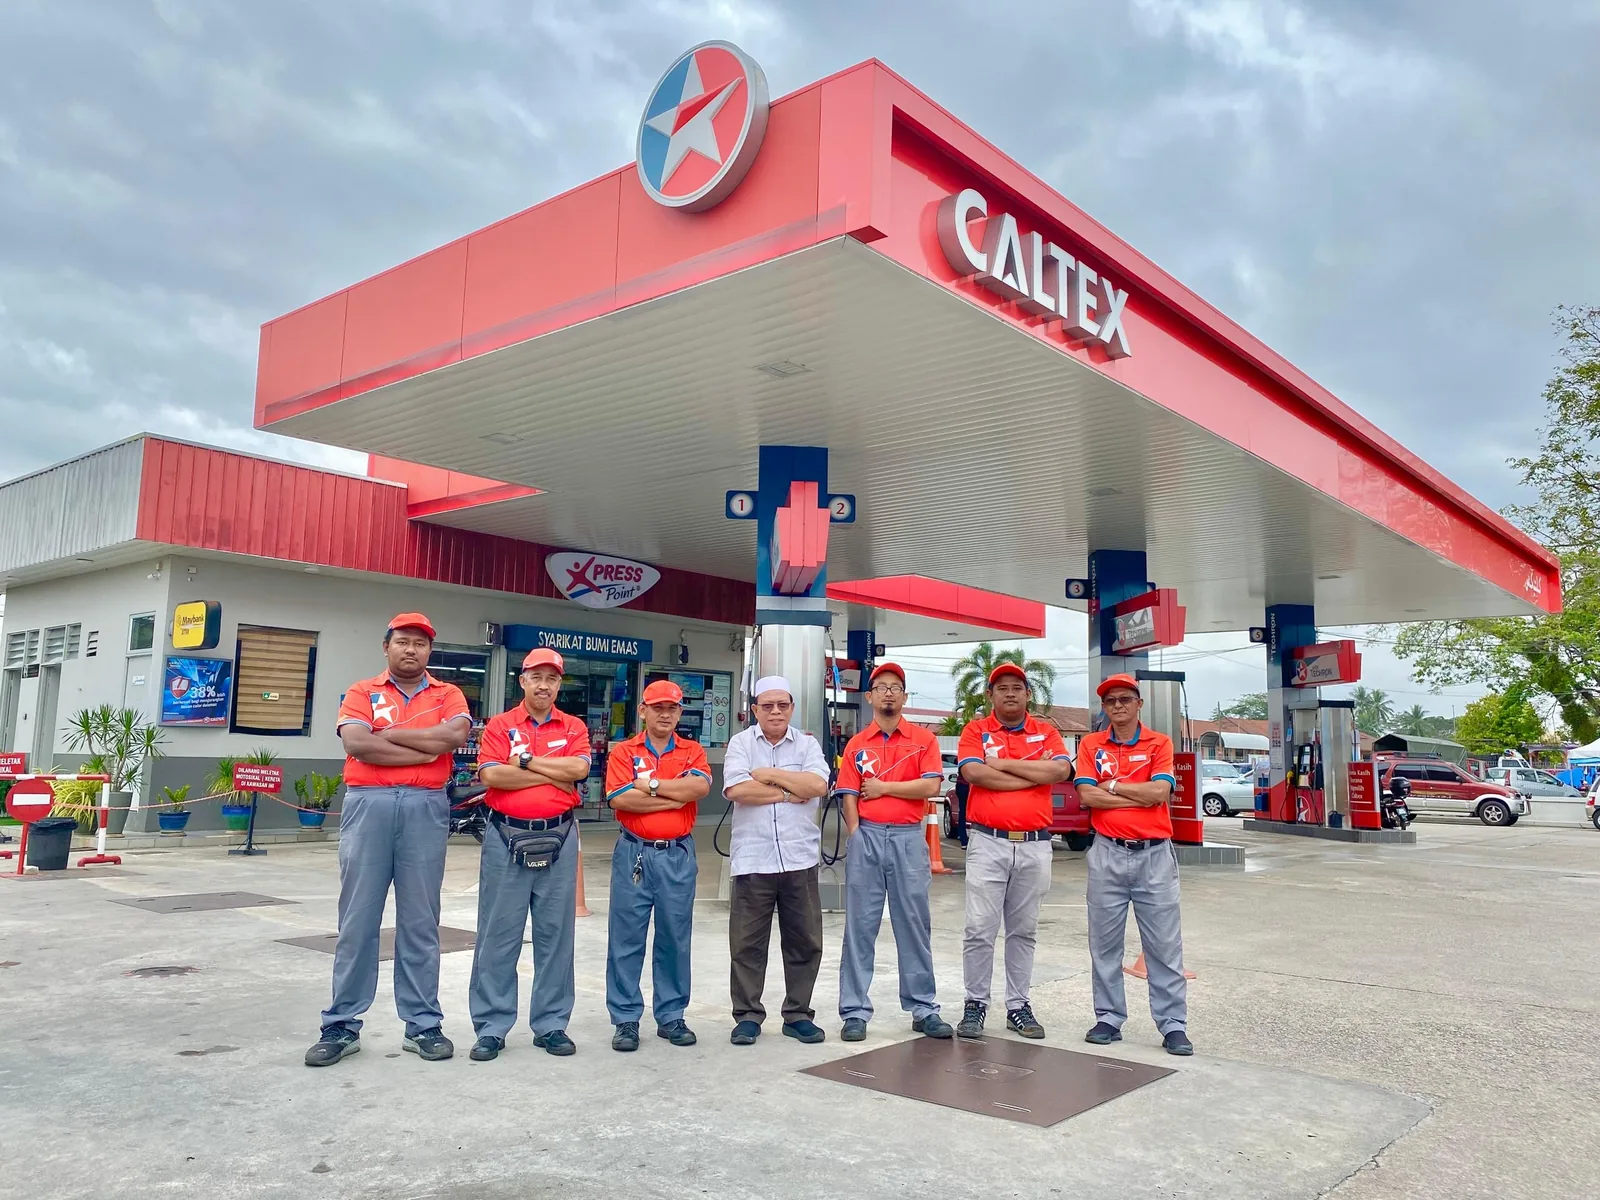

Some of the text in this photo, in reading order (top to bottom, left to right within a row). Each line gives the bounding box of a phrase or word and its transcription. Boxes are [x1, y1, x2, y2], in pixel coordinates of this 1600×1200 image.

[946, 188, 1132, 358] CALTEX
[738, 499, 744, 511] 1
[836, 502, 845, 515] 2
[606, 586, 635, 601] Point
[1073, 584, 1081, 593] 3
[181, 614, 204, 624] Maybank
[538, 631, 639, 656] SYARIKAT BUMI EMAS
[190, 686, 216, 699] 38%
[238, 767, 260, 775] DILARANG
[1177, 763, 1192, 771] Kasih
[527, 860, 548, 868] VANS
